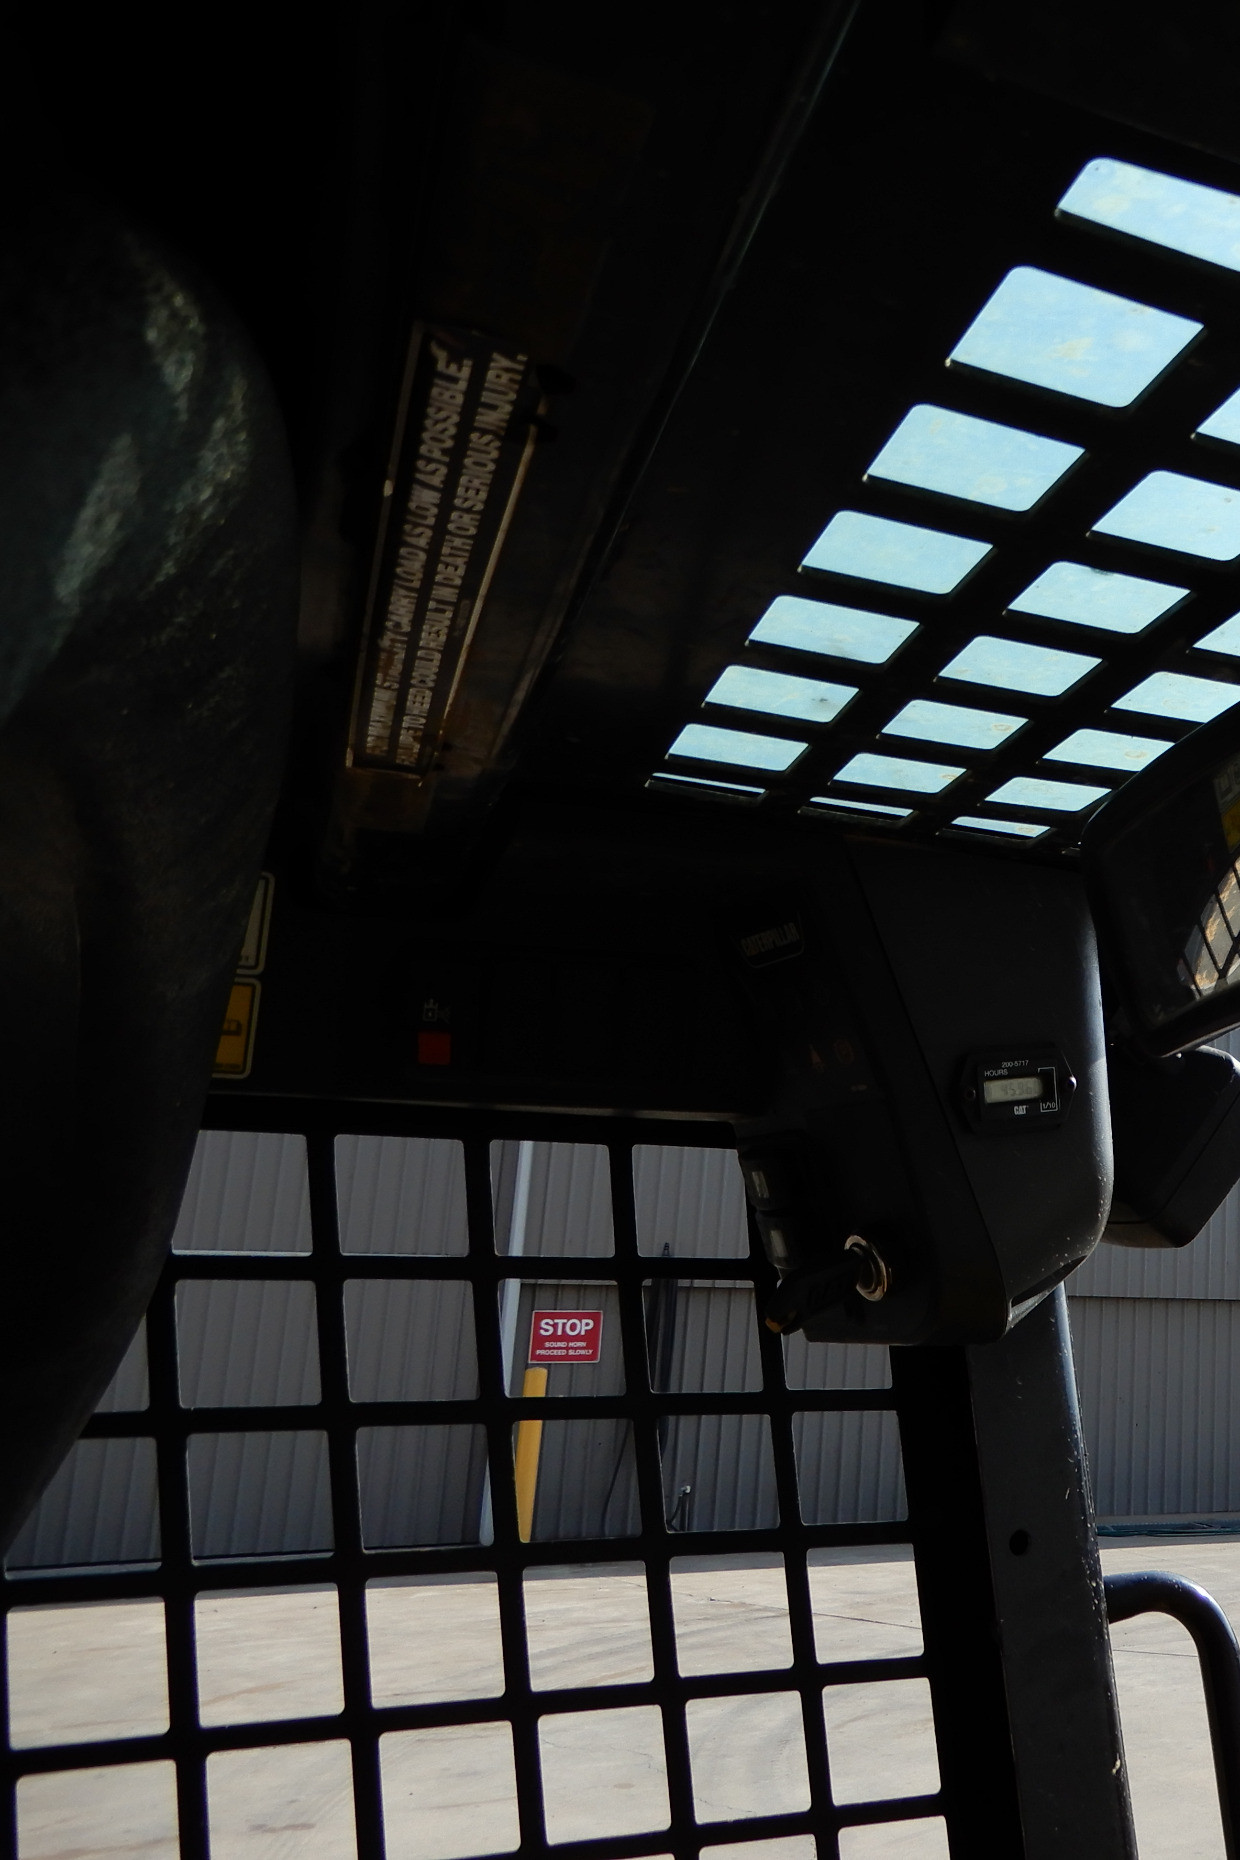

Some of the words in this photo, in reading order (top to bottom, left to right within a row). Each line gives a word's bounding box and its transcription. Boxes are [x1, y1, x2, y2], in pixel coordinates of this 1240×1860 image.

[414, 459, 447, 488] AS
[454, 432, 502, 511] SERIOUS
[406, 484, 441, 526] LOW
[401, 524, 433, 550] AS
[447, 510, 481, 537] OR
[395, 547, 427, 589] LOAD
[435, 535, 474, 587] DEATH
[430, 584, 460, 602] IN
[386, 585, 418, 633] CARRY
[419, 600, 454, 650] RESULT
[410, 650, 442, 688] COULD
[405, 688, 432, 716] HEED
[402, 715, 427, 730] TO
[1002, 1060, 1029, 1068] 200-5717
[1013, 1105, 1027, 1115] CAT
[540, 1319, 594, 1336] STOP
